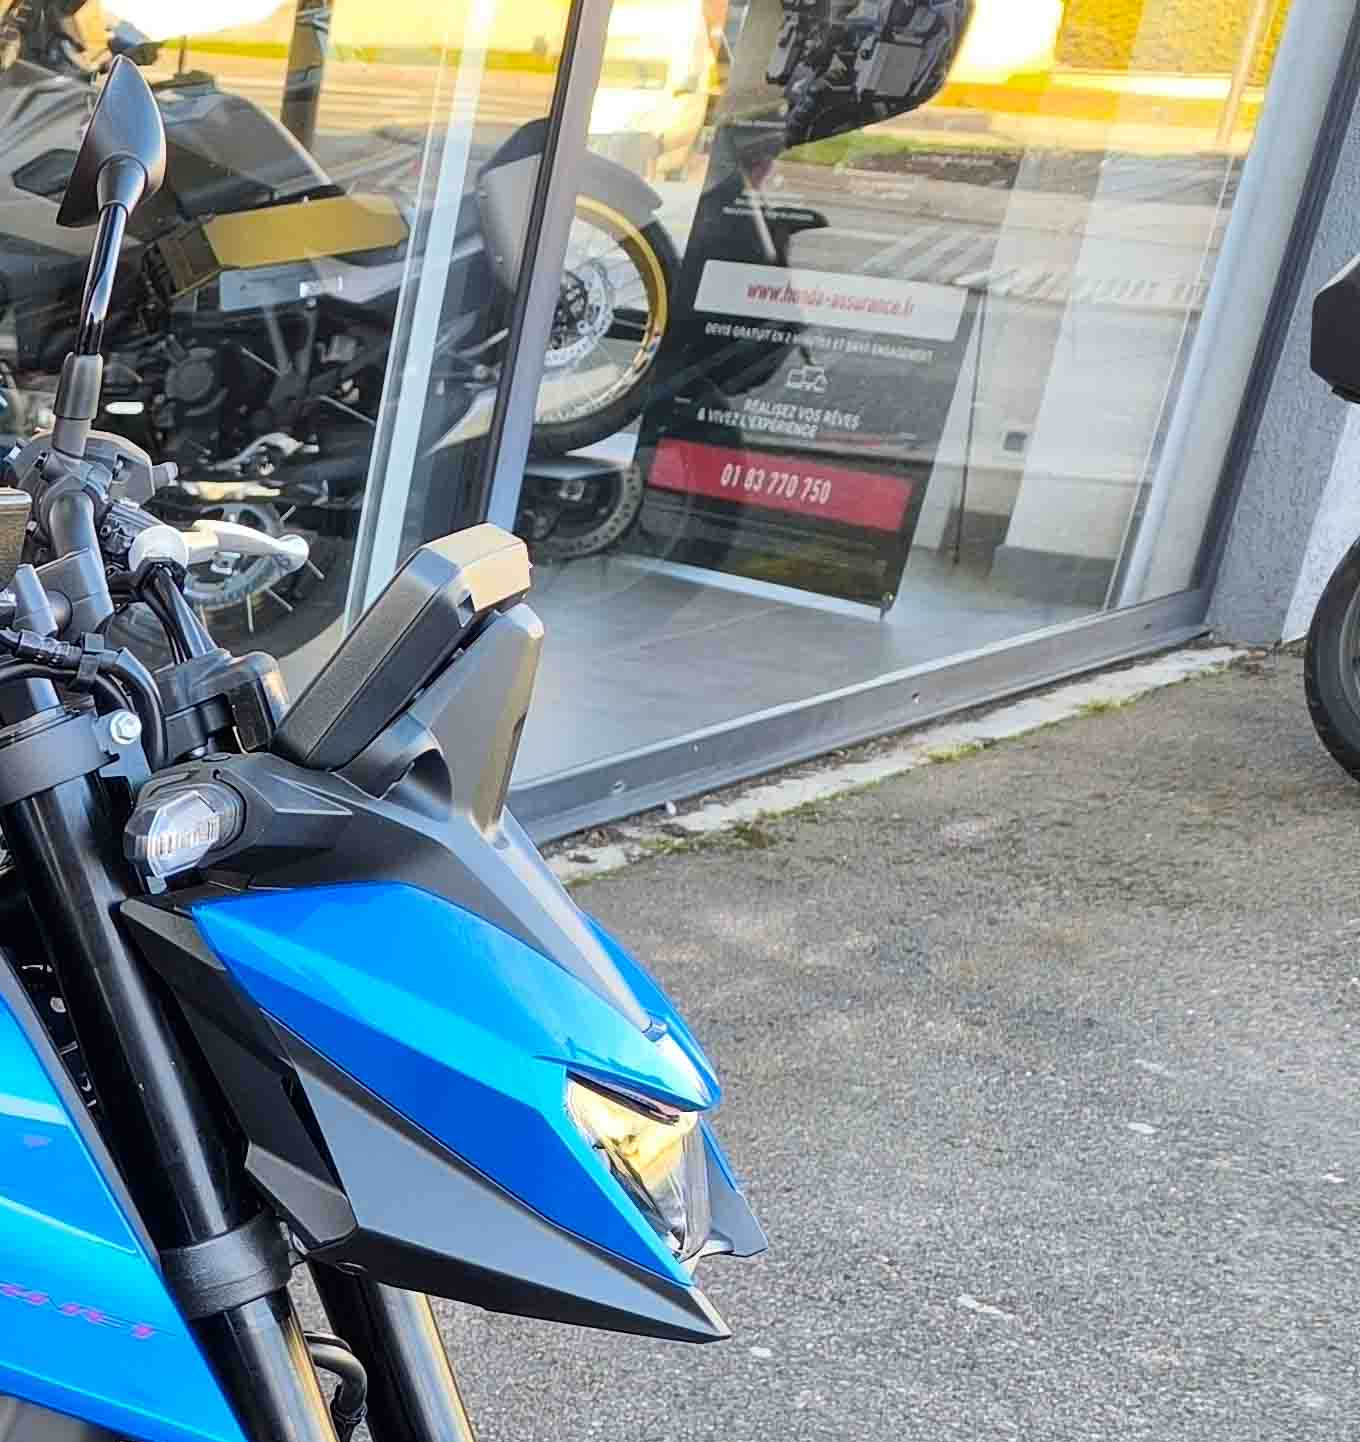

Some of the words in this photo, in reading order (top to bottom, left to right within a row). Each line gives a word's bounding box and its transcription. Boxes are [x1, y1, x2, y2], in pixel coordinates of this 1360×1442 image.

[720, 463, 740, 487] 01
[743, 466, 765, 492] 83
[766, 470, 800, 499] 770
[799, 476, 833, 505] 750
